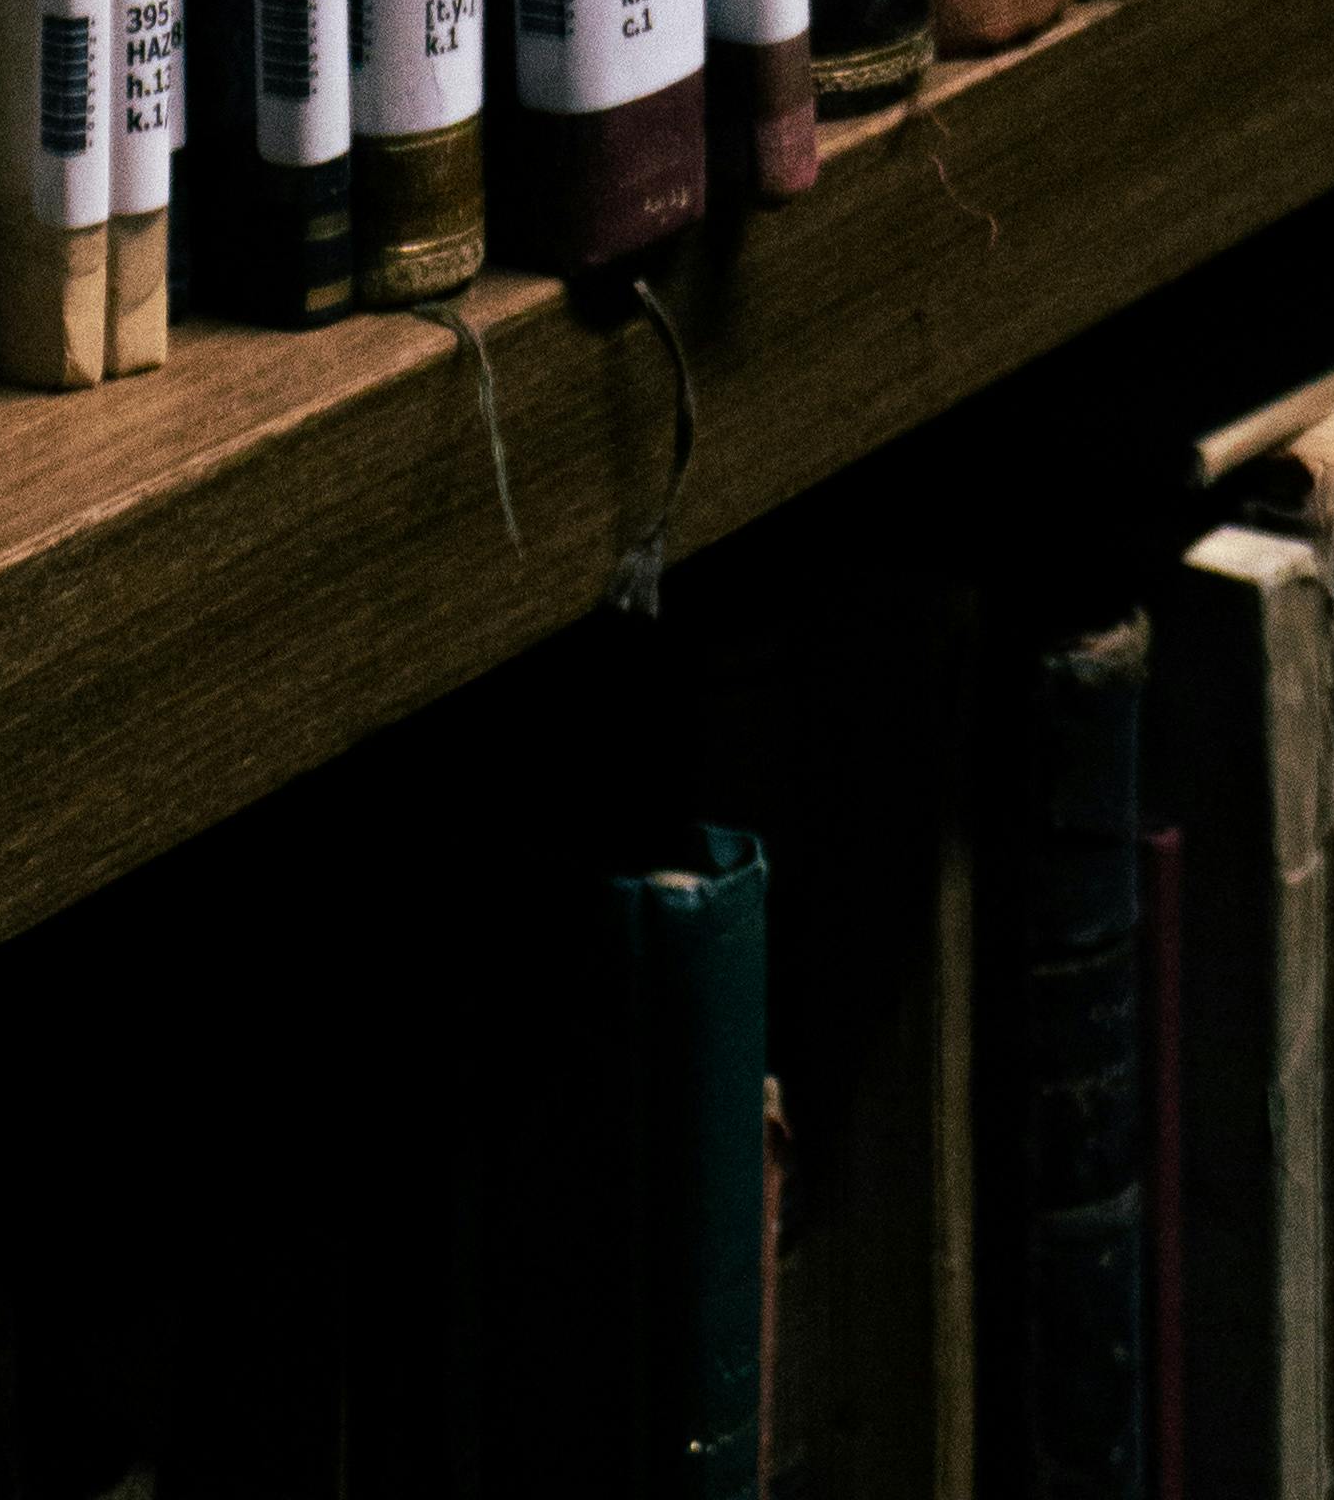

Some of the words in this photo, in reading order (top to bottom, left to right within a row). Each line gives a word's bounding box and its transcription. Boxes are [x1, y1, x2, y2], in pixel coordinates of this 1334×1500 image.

[621, 6, 654, 40] c.1
[126, 30, 172, 67] HAZ
[424, 26, 459, 58] k.1
